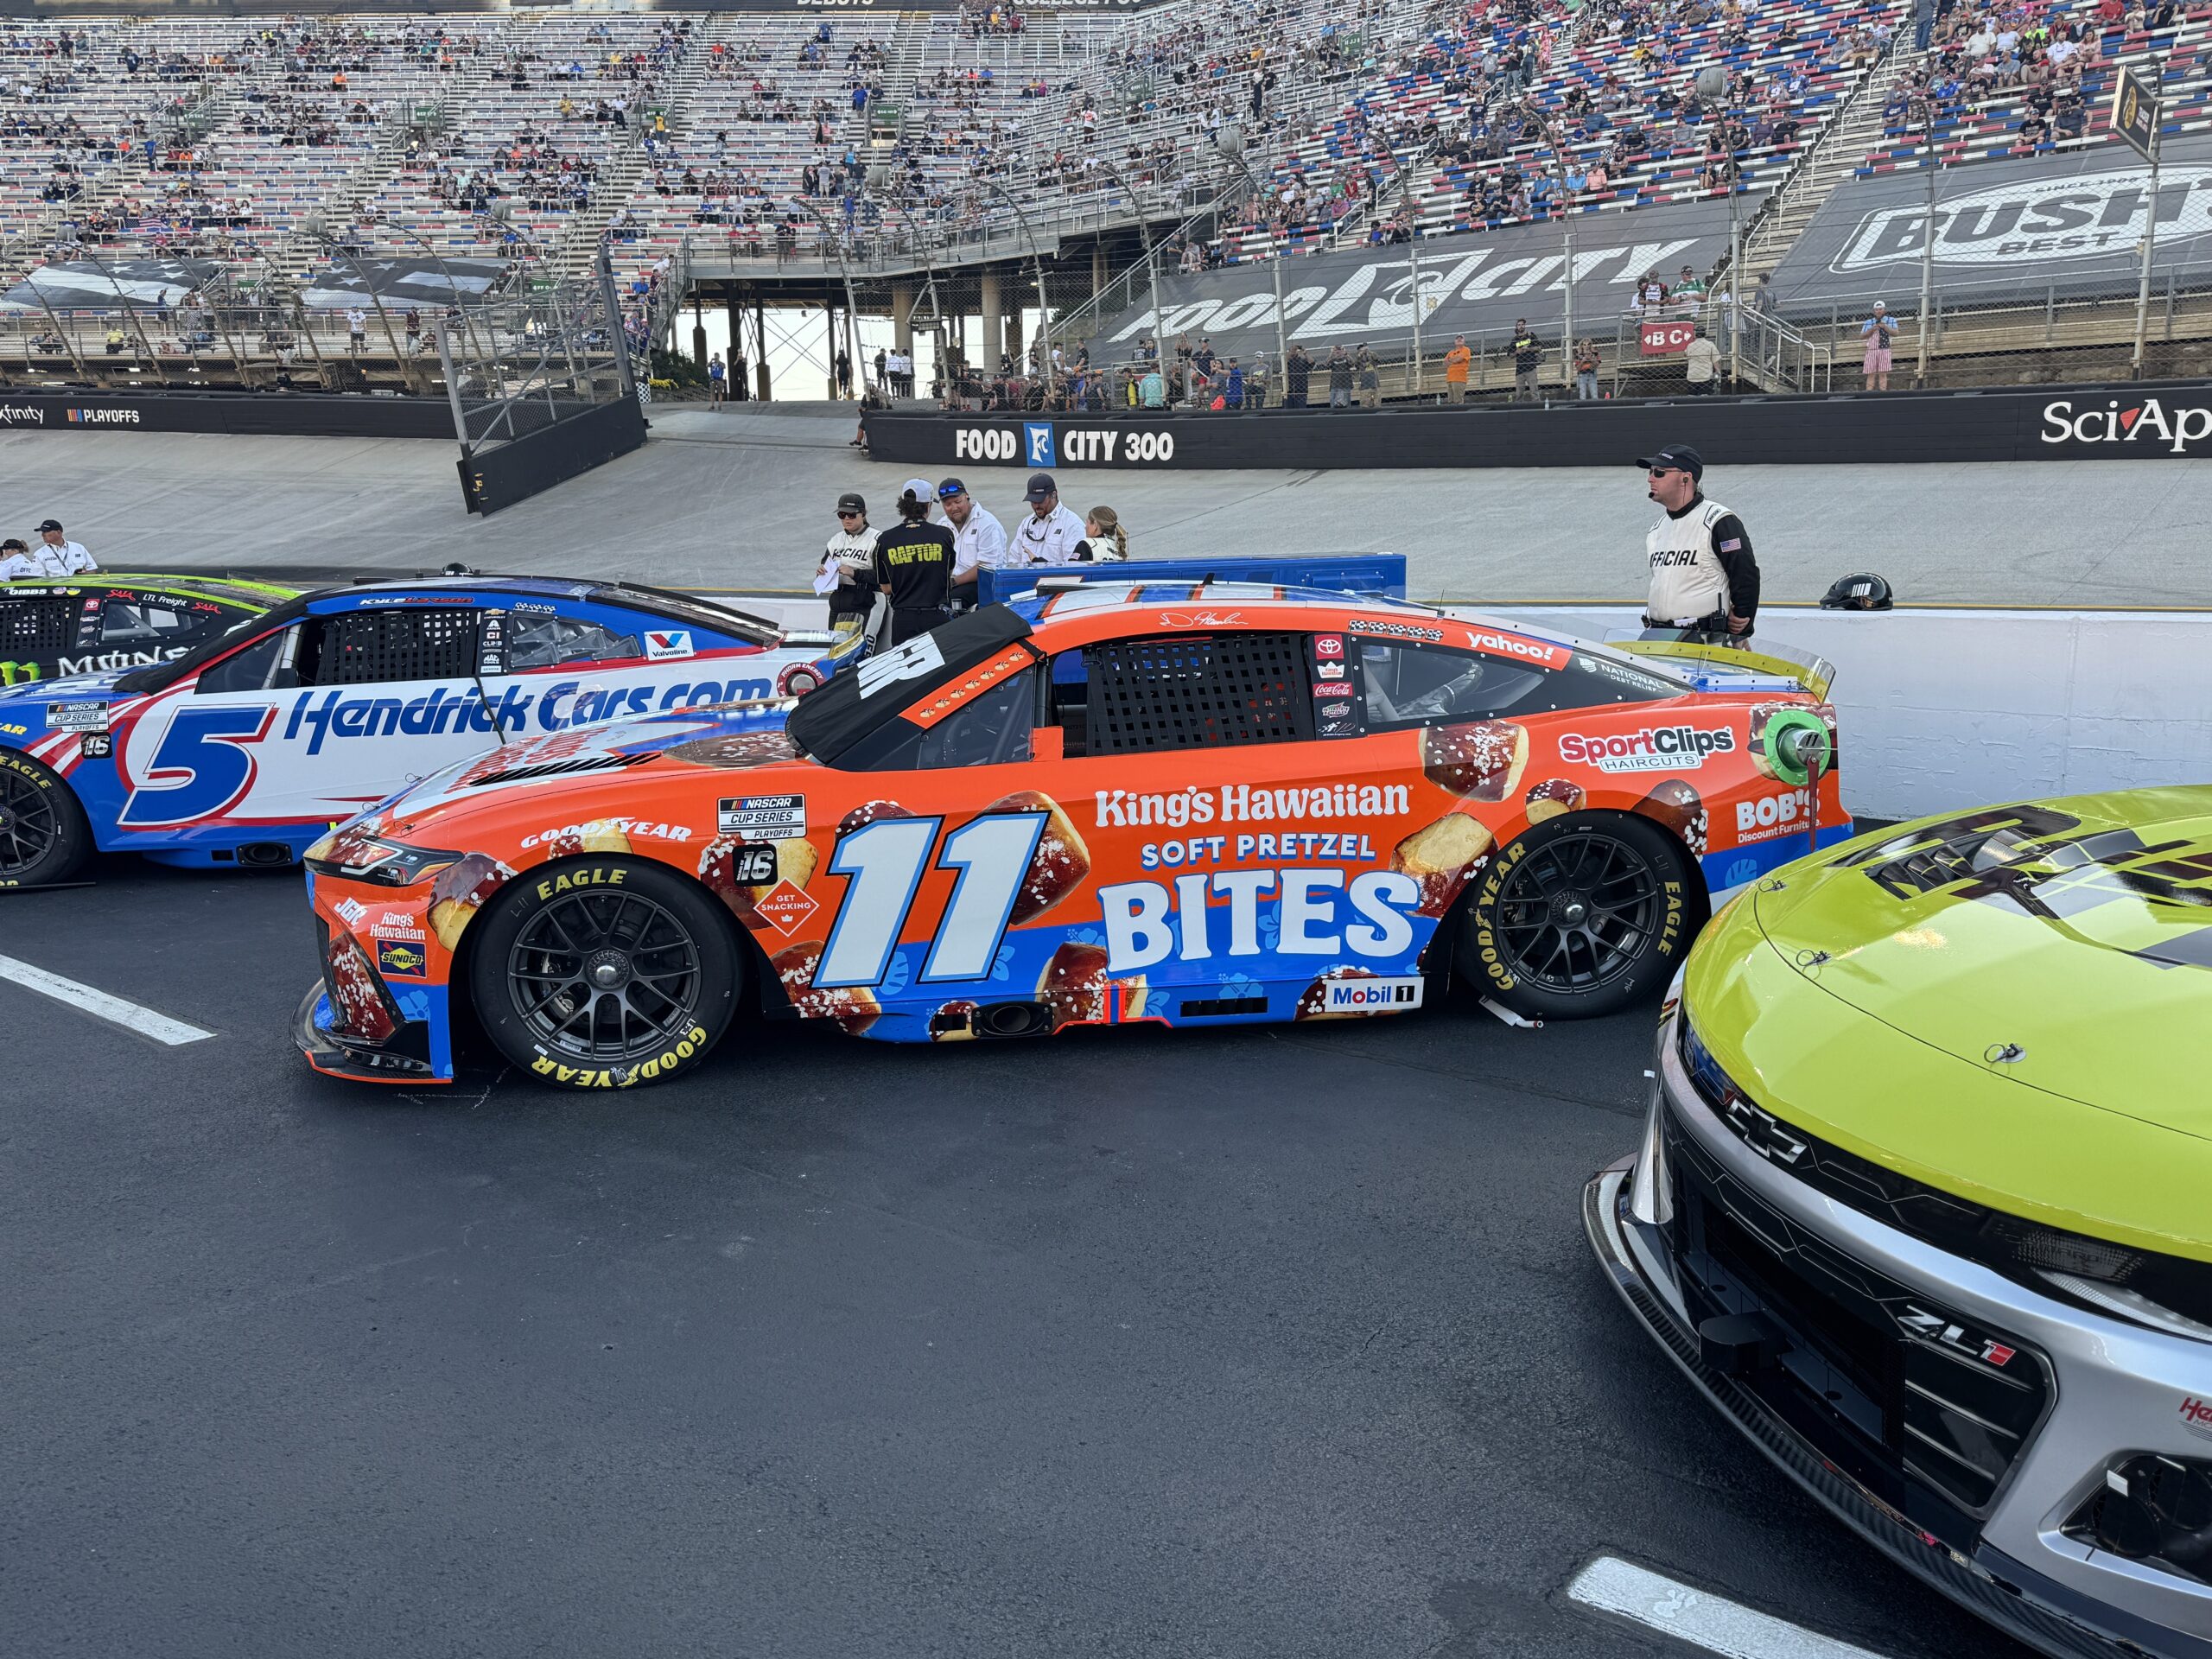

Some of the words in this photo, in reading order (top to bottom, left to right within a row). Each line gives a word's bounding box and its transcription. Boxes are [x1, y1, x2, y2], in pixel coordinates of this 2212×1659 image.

[1864, 178, 2212, 261] BUSH'
[1996, 232, 2120, 256] BEST
[1460, 238, 1699, 300] CITY
[1107, 285, 1325, 342] FOOD
[1653, 332, 1665, 346] B
[1669, 329, 1683, 344] C
[84, 410, 139, 423] PLAYOFFS
[957, 429, 1016, 460] FOOD
[1064, 430, 1118, 461] CITY
[1125, 432, 1173, 461] 300
[887, 543, 943, 565] RAPTOR
[106, 589, 136, 601] SAIA
[159, 596, 188, 607] Freight
[192, 601, 221, 614] SAIA
[652, 649, 688, 658] Valvoline
[1465, 632, 1554, 660] yahoo!
[781, 664, 801, 677] PHORM
[802, 664, 823, 679] ENERGY
[1600, 664, 1663, 690] NATIONAL
[1611, 674, 1630, 684] DEBT
[1632, 681, 1657, 692] RELIEF
[67, 702, 99, 711] NASCAR
[72, 713, 99, 721] SERIES
[86, 735, 110, 755] 16
[1560, 728, 1733, 762] SportClips
[117, 702, 277, 827] 5
[1605, 756, 1696, 771] HAIRCUTS
[747, 798, 791, 808] NASCAR
[1095, 786, 1214, 827] King's
[1221, 784, 1409, 821] Hawaiian
[731, 813, 753, 823] CUP
[754, 811, 793, 823] SERIES
[754, 829, 793, 837] PLAYOFFS
[1738, 827, 1778, 843] Discount
[1141, 836, 1225, 869] SOFT
[1236, 833, 1376, 861] PRETZEL
[741, 851, 774, 880] 16
[536, 868, 627, 901] EAGLE
[761, 901, 811, 912] SNACKING
[777, 894, 794, 903] GET
[808, 810, 1052, 989] 11
[334, 897, 368, 926] JGR
[381, 912, 414, 927] King's
[1097, 868, 1421, 973] BITES
[1478, 842, 1526, 990] GOODYEAR
[1657, 881, 1682, 956] EAGLE
[370, 924, 425, 940] Hawaiian
[381, 953, 423, 965] SUNOCO
[1333, 986, 1391, 1004] Mobil
[1397, 985, 1414, 1002] 1
[531, 1027, 707, 1087] GOODYEAR
[1897, 1305, 2016, 1366] ZL1
